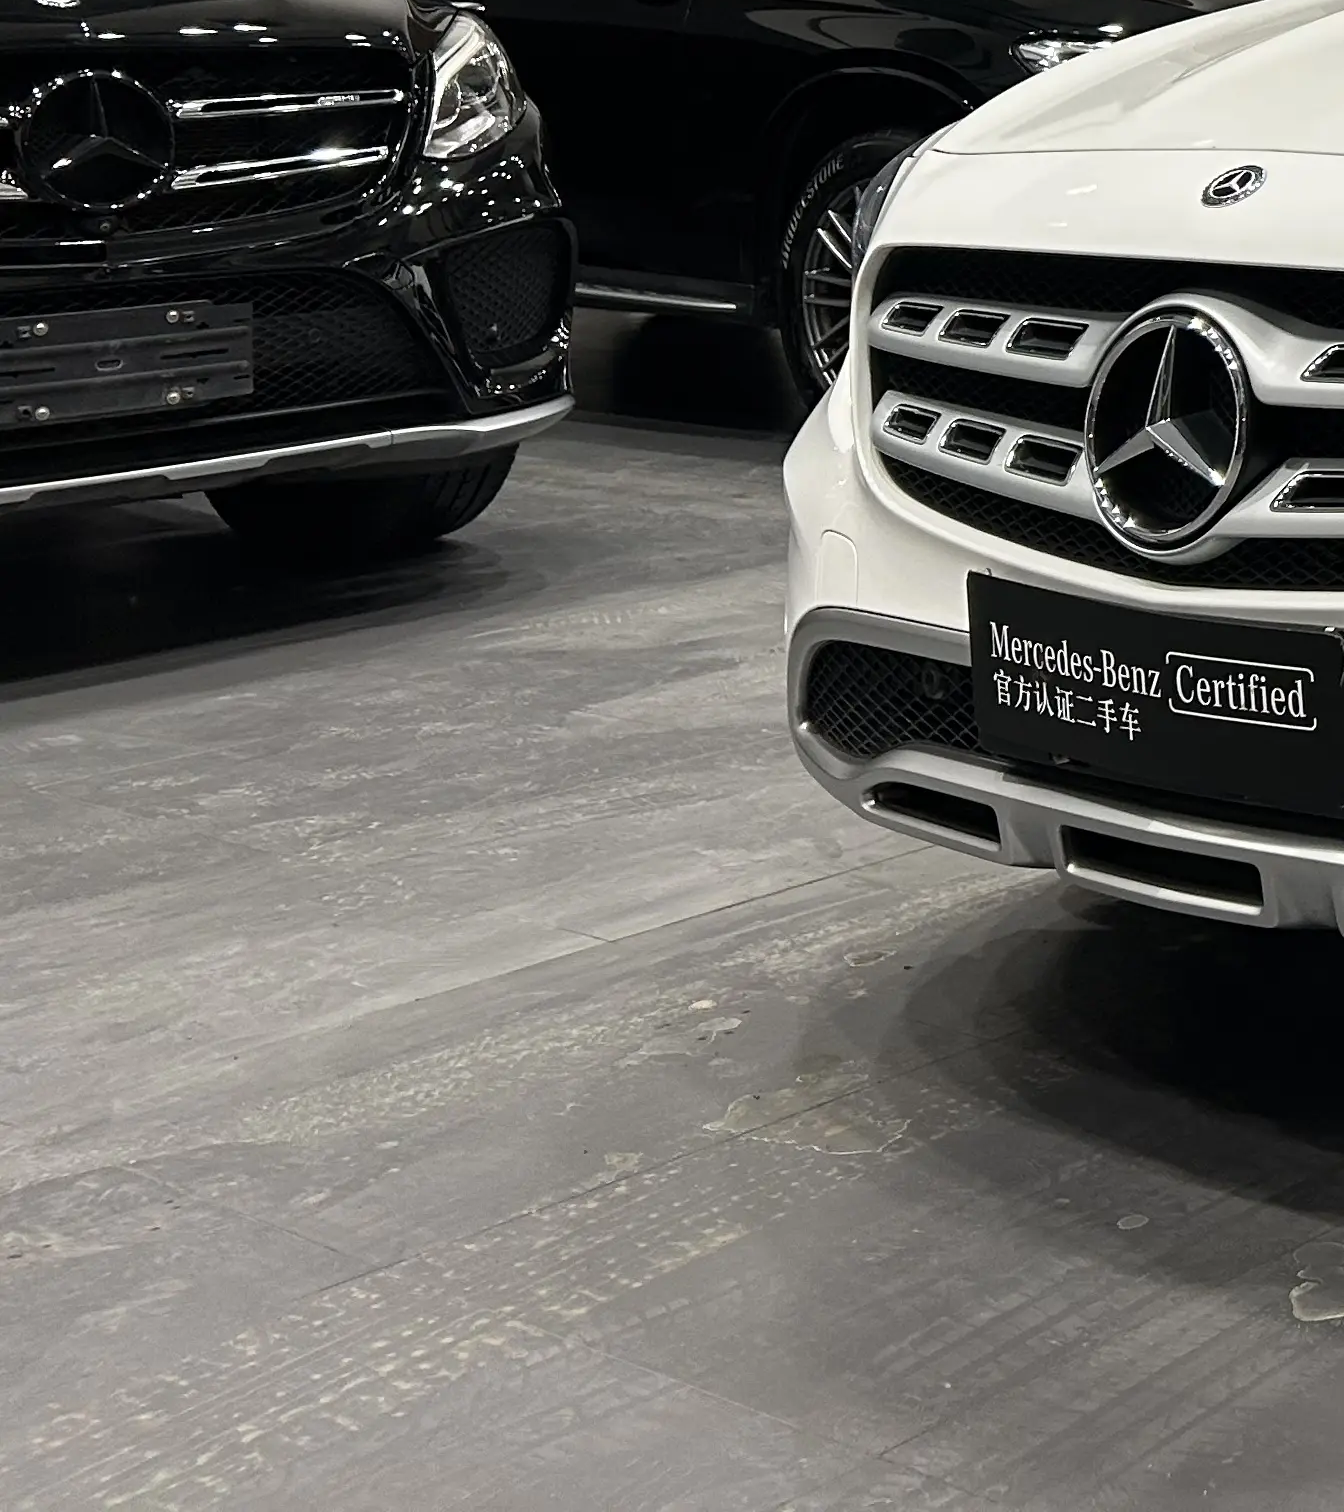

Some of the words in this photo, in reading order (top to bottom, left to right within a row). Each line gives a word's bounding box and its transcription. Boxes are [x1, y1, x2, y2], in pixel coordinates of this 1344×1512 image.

[989, 621, 1162, 698] Mercedes-Benz
[1175, 664, 1307, 718] Certified
[993, 668, 1142, 742] 官方认证二手车
